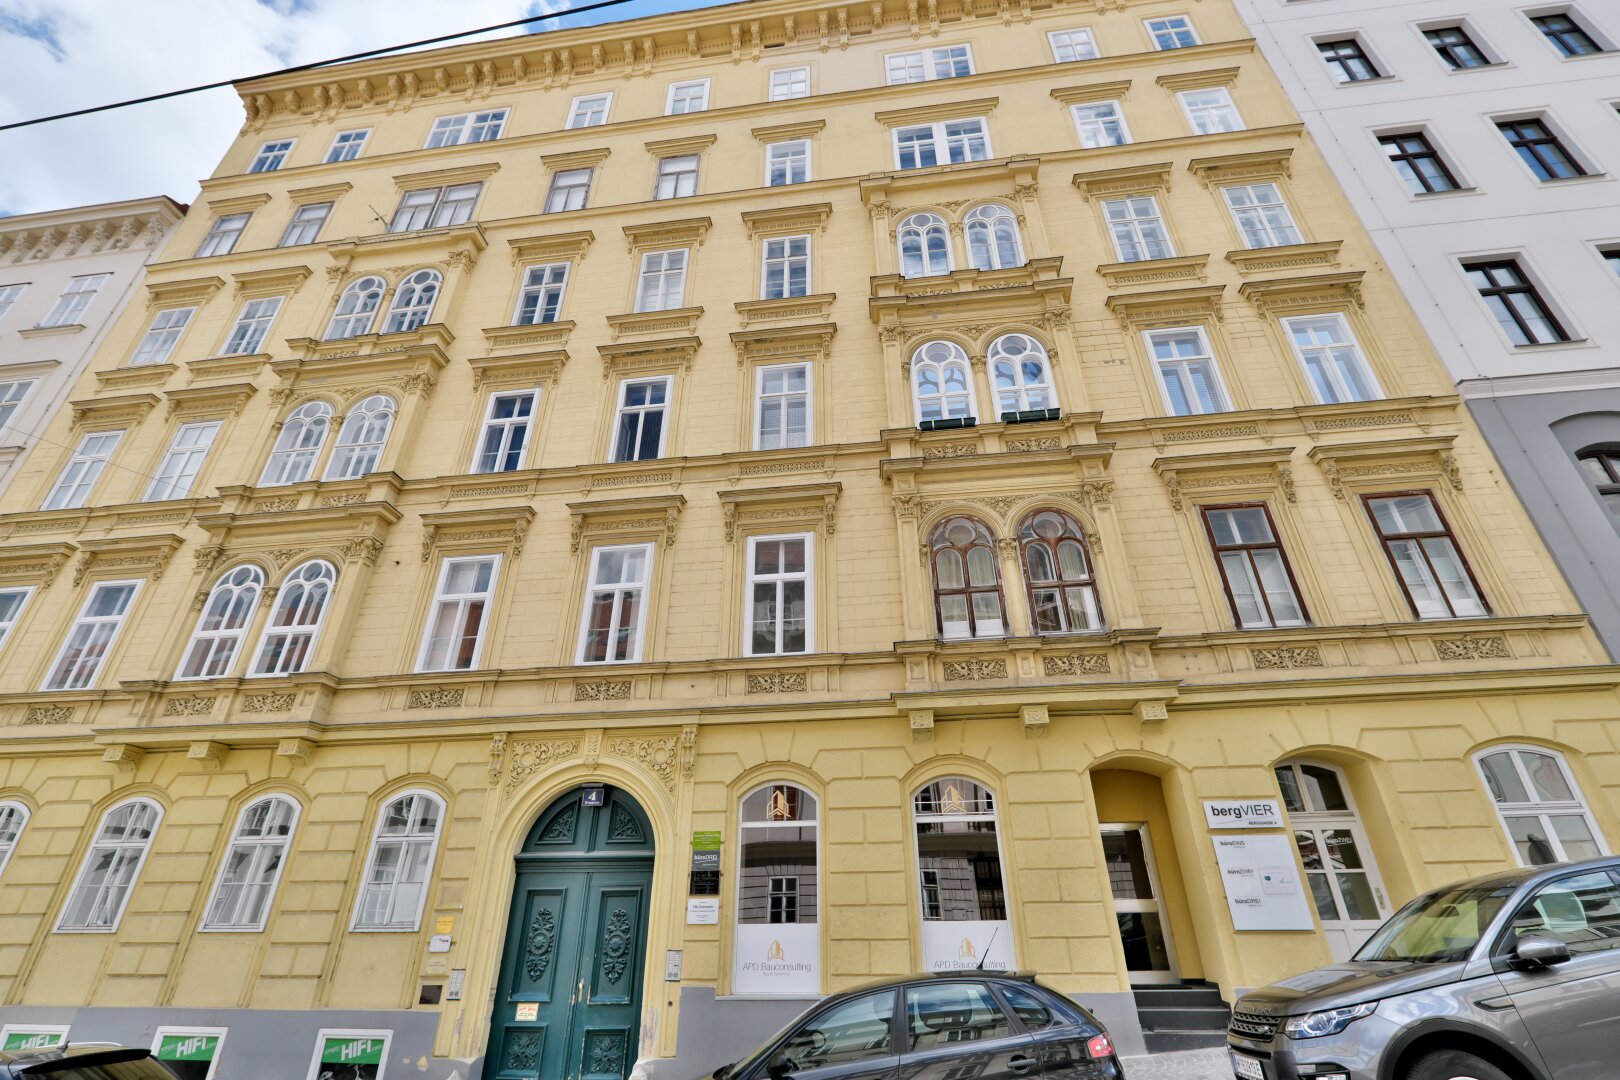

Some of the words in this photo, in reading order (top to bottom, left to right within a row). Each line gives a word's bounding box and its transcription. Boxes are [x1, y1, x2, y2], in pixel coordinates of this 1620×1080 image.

[588, 792, 597, 801] 4
[1211, 804, 1274, 818] bergVIER
[743, 962, 759, 971] APD
[761, 962, 812, 972] Bauconsulting
[934, 960, 951, 969] APD
[20, 1034, 50, 1049] HIFI
[176, 1037, 207, 1058] HIFI
[341, 1039, 372, 1061] HIFI
